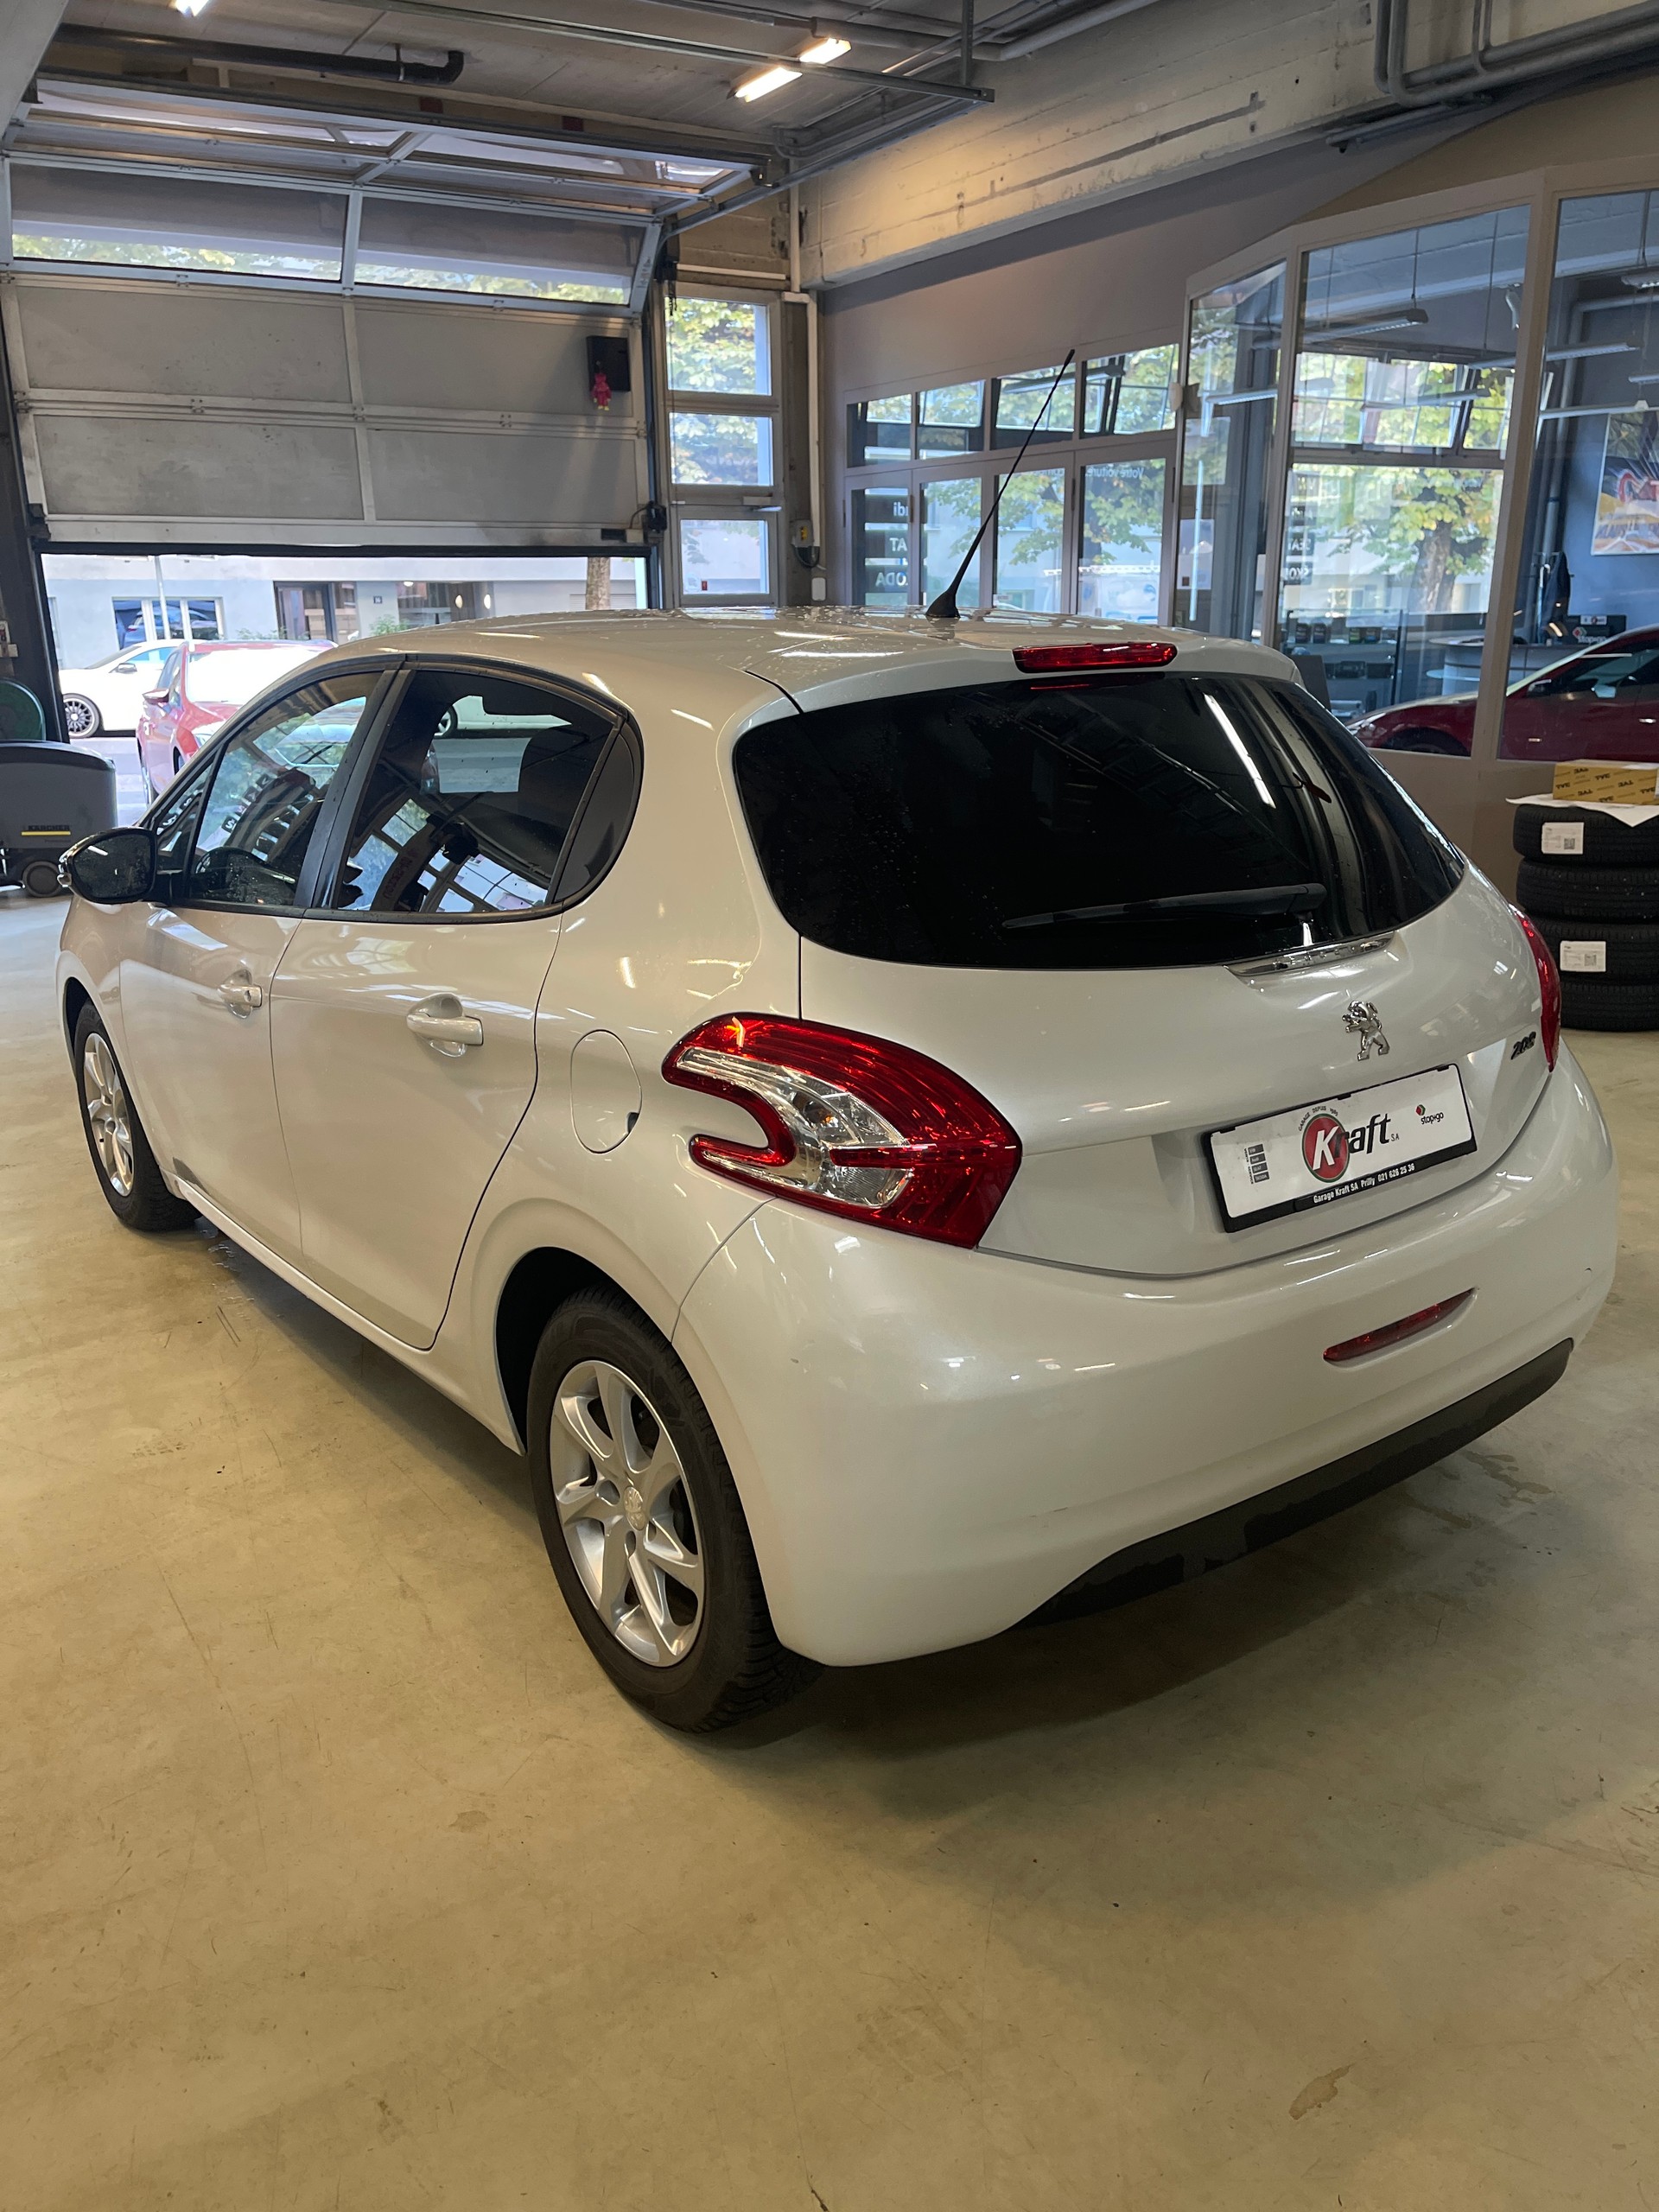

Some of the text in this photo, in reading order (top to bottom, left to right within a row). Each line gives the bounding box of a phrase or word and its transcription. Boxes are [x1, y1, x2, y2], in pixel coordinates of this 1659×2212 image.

[1298, 1112, 1310, 1132] GARAGE
[1313, 1113, 1400, 1171] Kraft SA
[1313, 1191, 1335, 1204] Garage
[1335, 1185, 1351, 1197] Kraft
[1350, 1182, 1358, 1192] SA
[1361, 1177, 1376, 1188] Prilly
[1377, 1172, 1388, 1182] 021
[1400, 1165, 1408, 1175] 25
